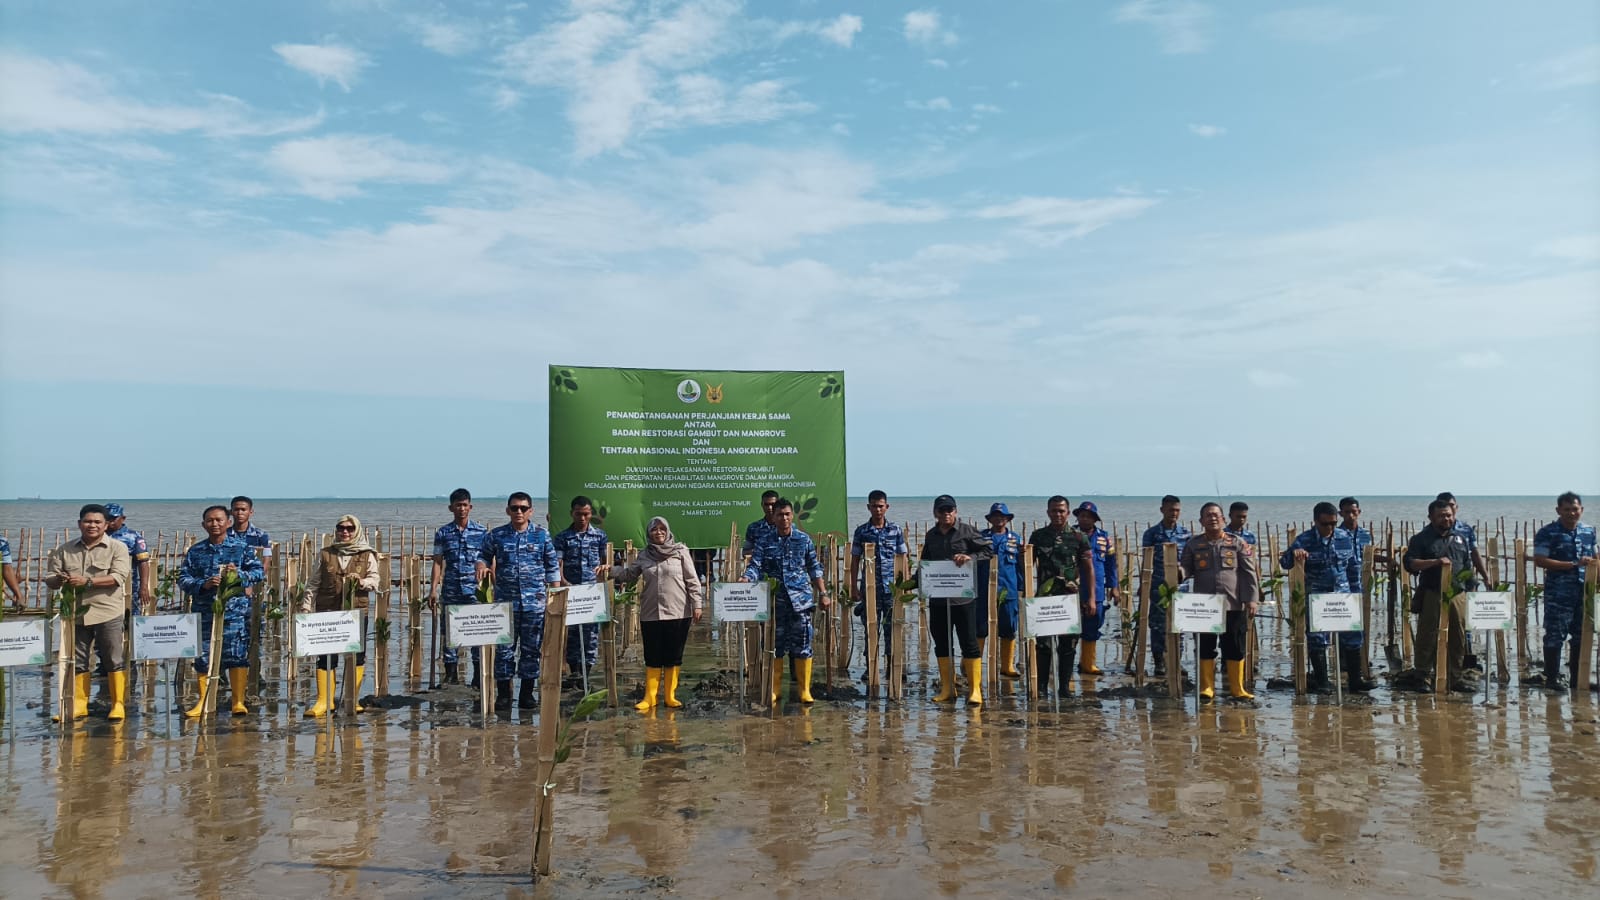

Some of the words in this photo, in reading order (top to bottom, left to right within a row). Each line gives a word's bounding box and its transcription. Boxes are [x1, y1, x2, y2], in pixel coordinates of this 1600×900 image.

[606, 411, 690, 420] PENANDATANGANAN
[691, 412, 741, 420] PERJANJIAN
[742, 412, 767, 420] KERJA
[768, 412, 791, 420] SAMA
[612, 429, 640, 437] BADAN
[641, 429, 686, 437] RESTORASI
[687, 429, 721, 437] GAMBUT
[692, 438, 710, 446] DAN
[601, 446, 638, 454] TENTARA
[639, 446, 681, 454] NASIONAL
[768, 473, 795, 481] RANGKA
[750, 481, 781, 489] REPUBLIK
[781, 481, 816, 489] INDONESIA
